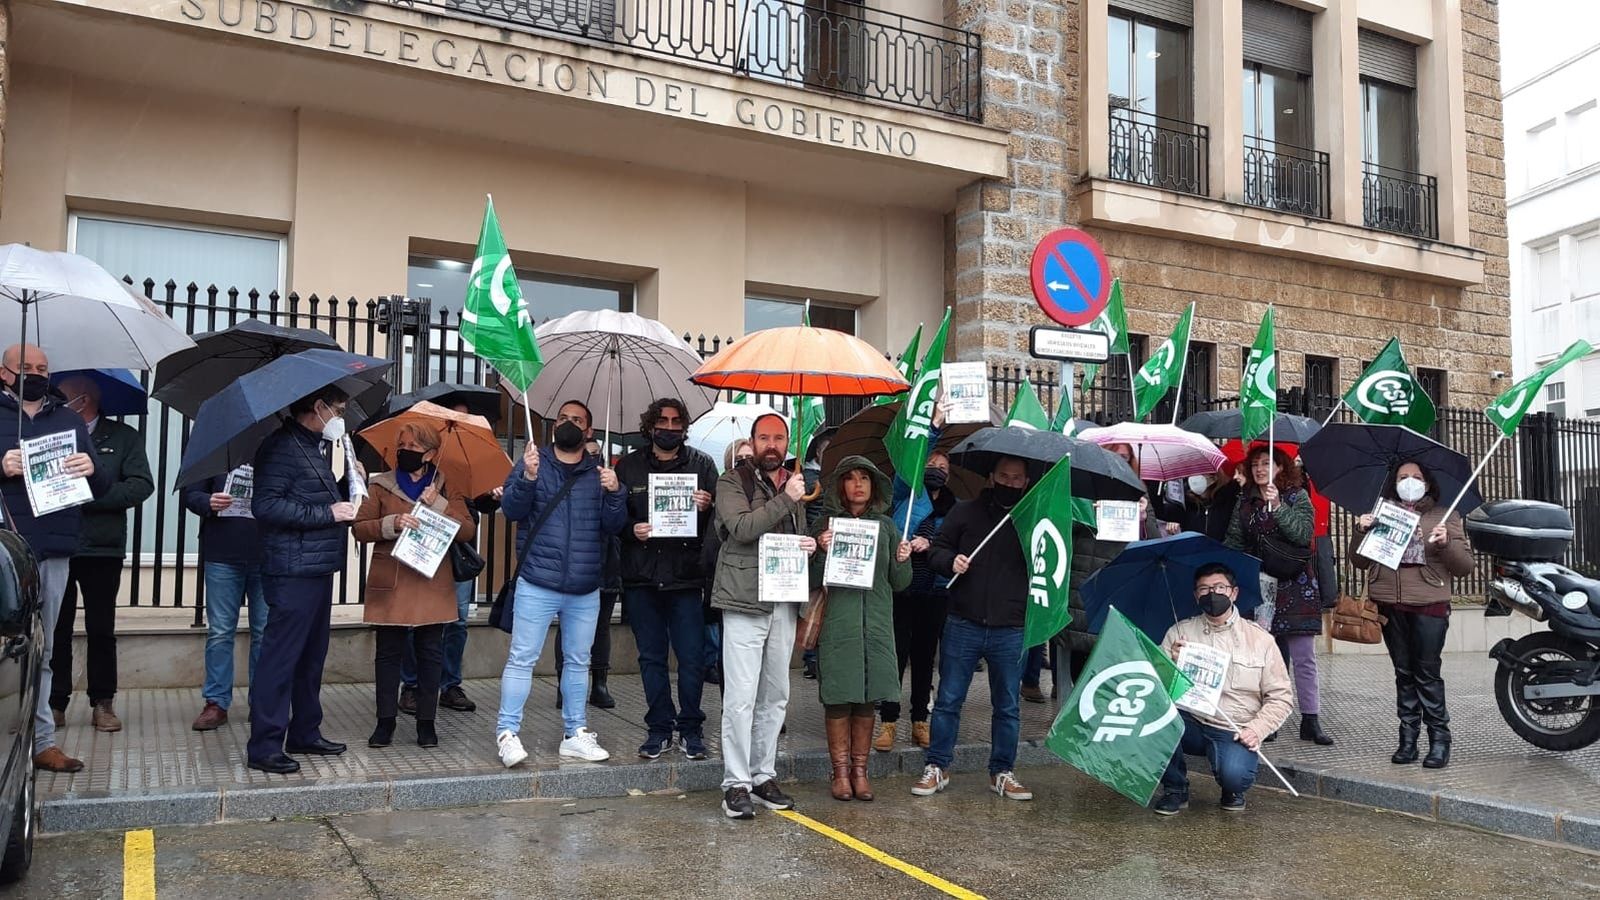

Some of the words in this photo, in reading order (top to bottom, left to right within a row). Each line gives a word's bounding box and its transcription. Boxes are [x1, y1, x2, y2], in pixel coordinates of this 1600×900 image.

[181, 0, 608, 98] SUBDELEGACION
[635, 76, 708, 117] DEL
[736, 98, 916, 157] GOBIERNO
[1375, 380, 1410, 416] CSIF
[668, 496, 690, 511] ¡YA!
[1030, 533, 1049, 609] CSIF
[1092, 678, 1155, 742] CSIF
